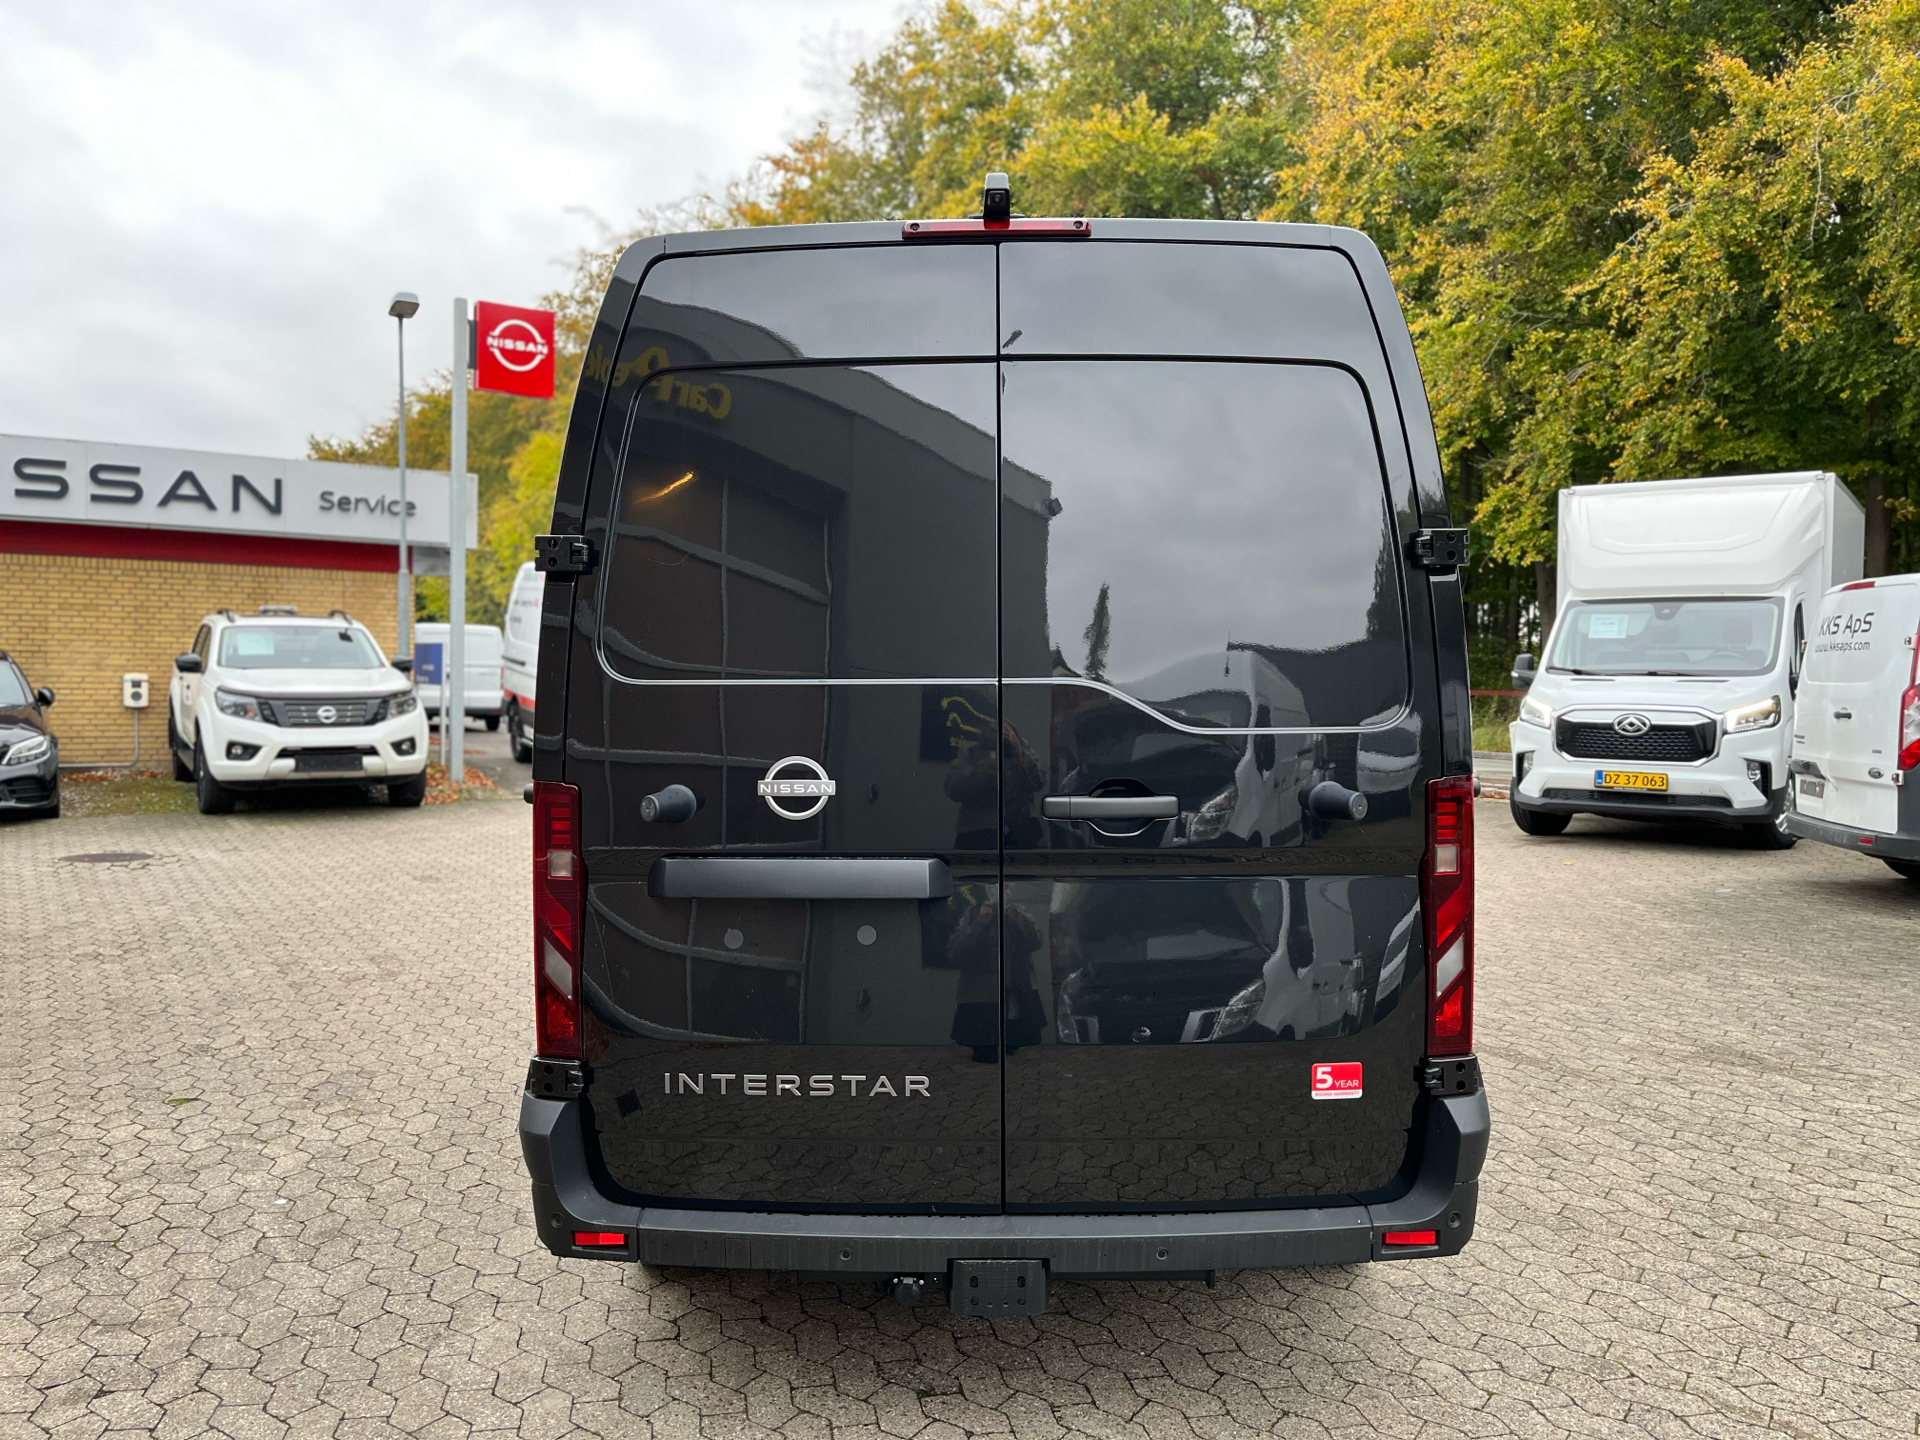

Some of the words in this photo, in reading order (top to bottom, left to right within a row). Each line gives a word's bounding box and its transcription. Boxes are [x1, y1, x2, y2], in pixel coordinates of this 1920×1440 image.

[486, 335, 548, 355] NISSAN
[319, 490, 416, 516] Service
[1819, 615, 1842, 636] KKS
[1843, 612, 1875, 638] ApS
[760, 784, 832, 793] NISSAN
[1604, 773, 1620, 785] DZ
[1624, 774, 1639, 786] 37
[1642, 775, 1665, 787] 063
[664, 1072, 931, 1097] INTERSTAR
[1315, 1066, 1333, 1089] 5
[1334, 1079, 1359, 1088] YEAR
